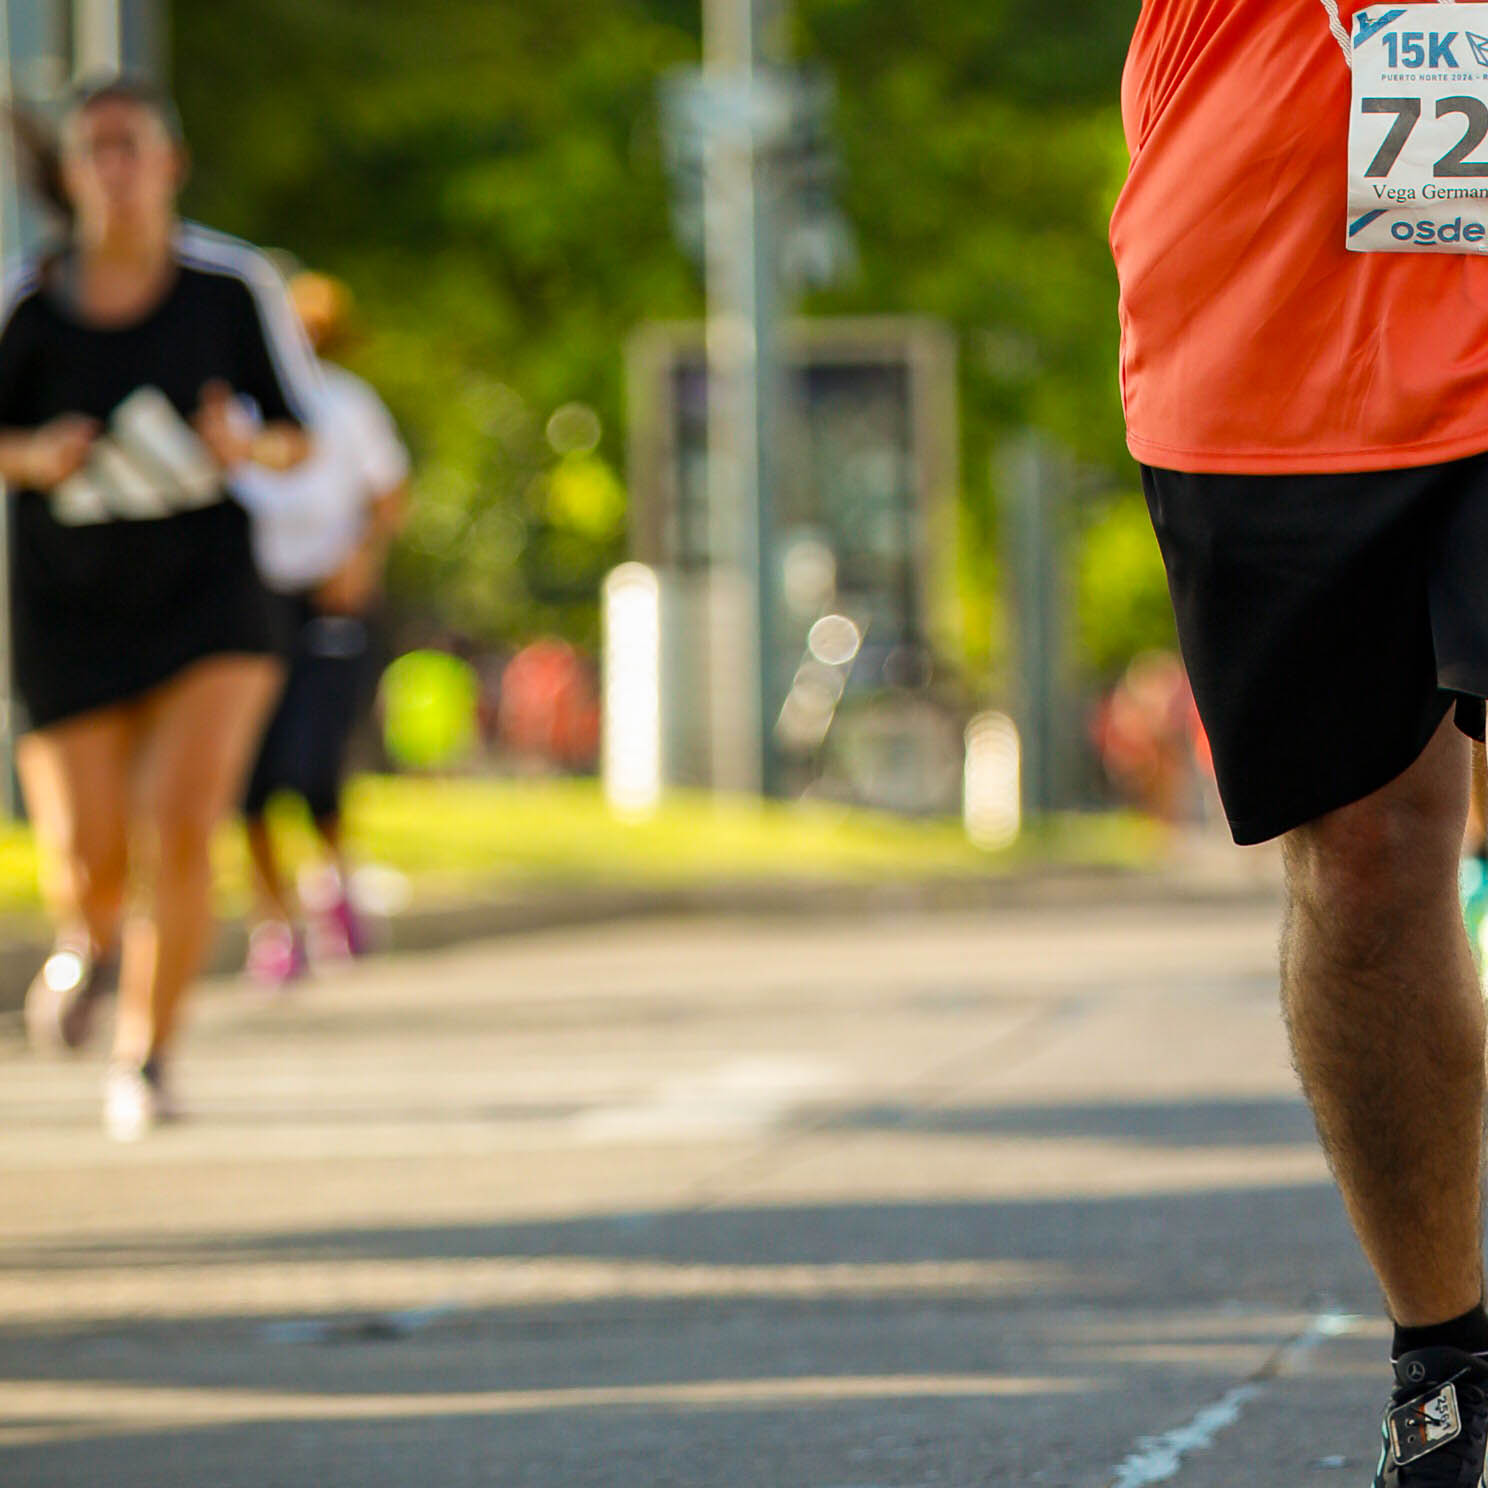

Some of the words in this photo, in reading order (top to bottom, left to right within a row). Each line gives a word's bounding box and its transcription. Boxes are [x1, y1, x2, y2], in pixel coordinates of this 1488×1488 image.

[1382, 31, 1460, 69] 15K
[1381, 73, 1416, 81] PUERTO
[1419, 73, 1448, 81] NORTE
[1373, 184, 1416, 203] Vega
[1391, 216, 1486, 244] osde
